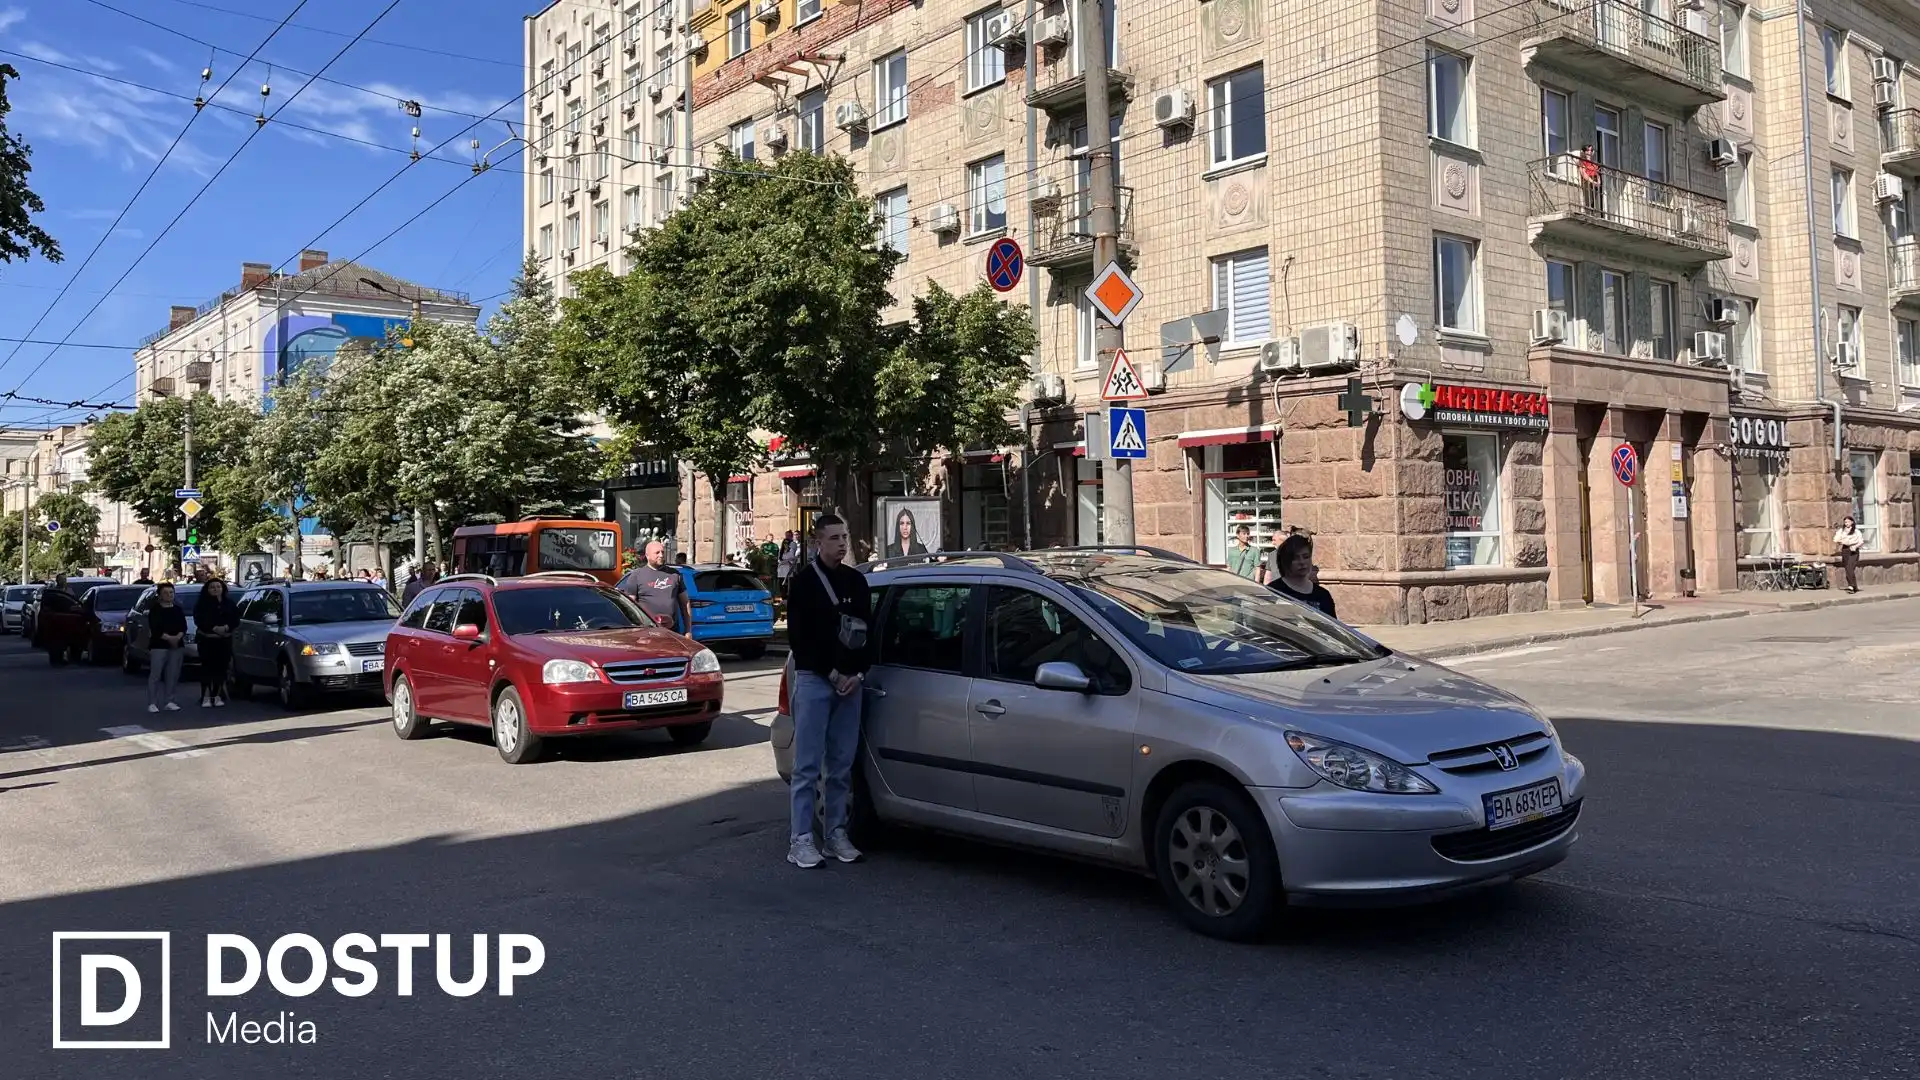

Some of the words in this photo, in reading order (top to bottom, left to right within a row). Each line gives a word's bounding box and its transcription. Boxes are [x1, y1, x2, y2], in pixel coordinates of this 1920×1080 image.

[1436, 411, 1472, 423] ГОЛОВНА
[1474, 413, 1502, 424] АПТЕКА
[1504, 416, 1527, 426] ТВОГО
[1528, 417, 1549, 428] МІСТА
[1729, 416, 1790, 447] GOGOL
[600, 533, 613, 546] 77
[631, 694, 646, 706] BA
[648, 691, 669, 704] 5425
[671, 690, 684, 702] CA
[1495, 796, 1514, 820] BA
